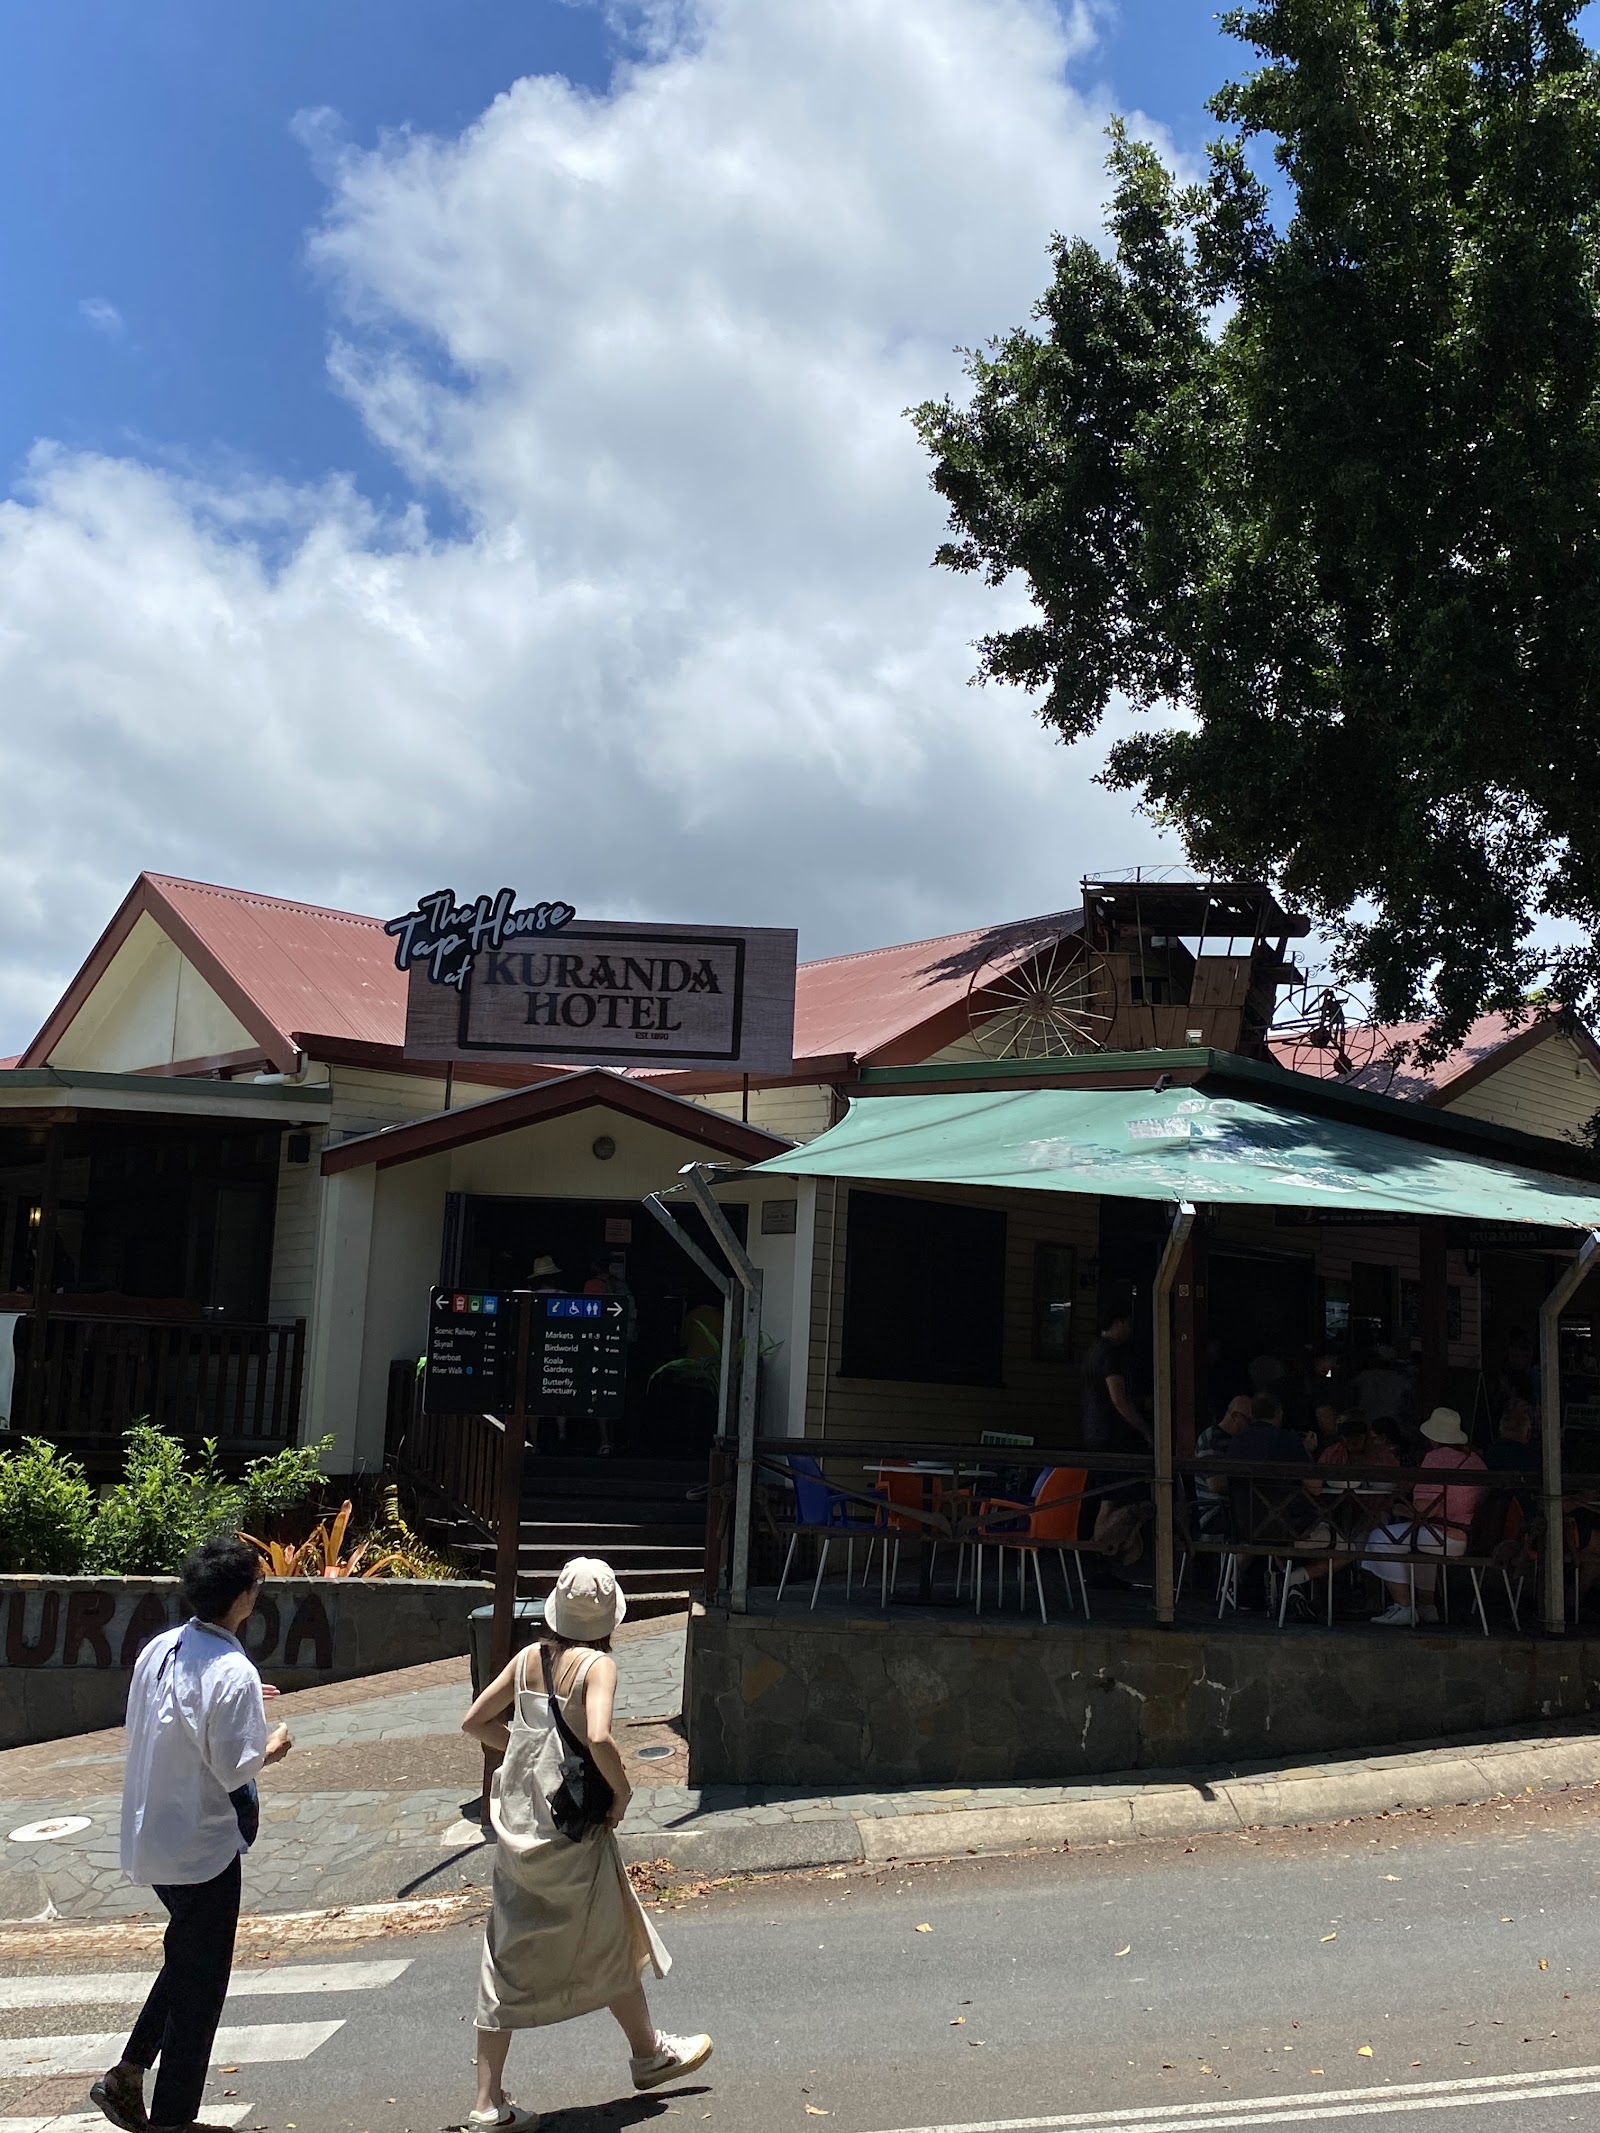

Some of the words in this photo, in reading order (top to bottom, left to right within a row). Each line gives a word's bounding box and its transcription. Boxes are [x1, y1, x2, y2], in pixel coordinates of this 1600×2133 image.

[422, 893, 476, 933] The
[389, 914, 466, 979] Tap
[468, 892, 571, 950] House
[444, 955, 472, 990] at
[484, 951, 722, 994] KURANDA
[523, 991, 682, 1031] HOTEL
[434, 1326, 454, 1335] Scenic
[455, 1327, 476, 1338] Railway
[545, 1330, 574, 1339] Markets
[433, 1339, 453, 1350] Skyrail
[544, 1343, 579, 1353] Birdworld
[432, 1352, 461, 1361] Riverboat
[543, 1356, 564, 1365] Koala
[431, 1365, 447, 1374] River
[448, 1366, 464, 1375] Walk
[543, 1364, 573, 1374] Gardens
[542, 1377, 573, 1388] Butterfly
[541, 1386, 578, 1397] Sanctuary
[0, 1590, 333, 1668] URADA
